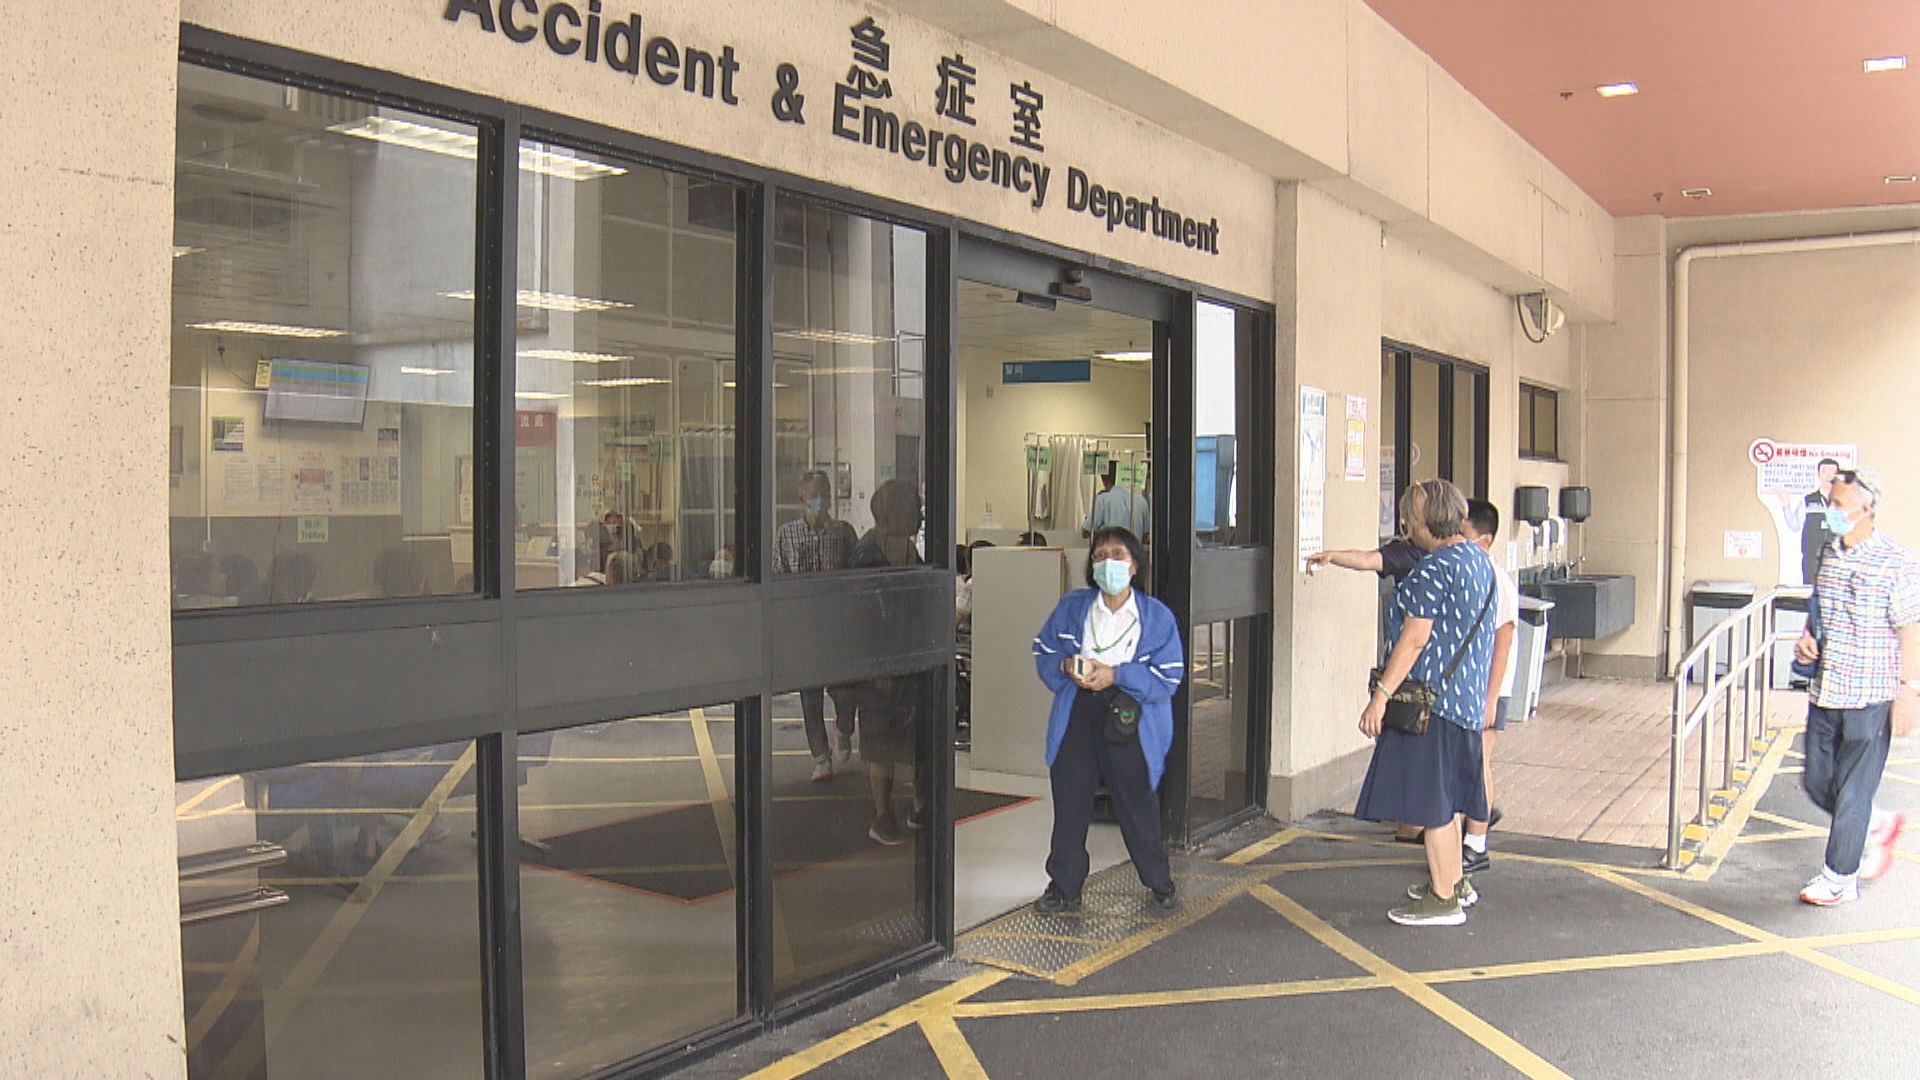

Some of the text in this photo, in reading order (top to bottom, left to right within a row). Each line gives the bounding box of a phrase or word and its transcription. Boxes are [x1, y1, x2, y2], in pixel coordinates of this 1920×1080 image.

[771, 62, 806, 125] &
[832, 82, 1051, 209] Emergency
[1067, 166, 1220, 255] Department
[847, 16, 1045, 152] 急症室
